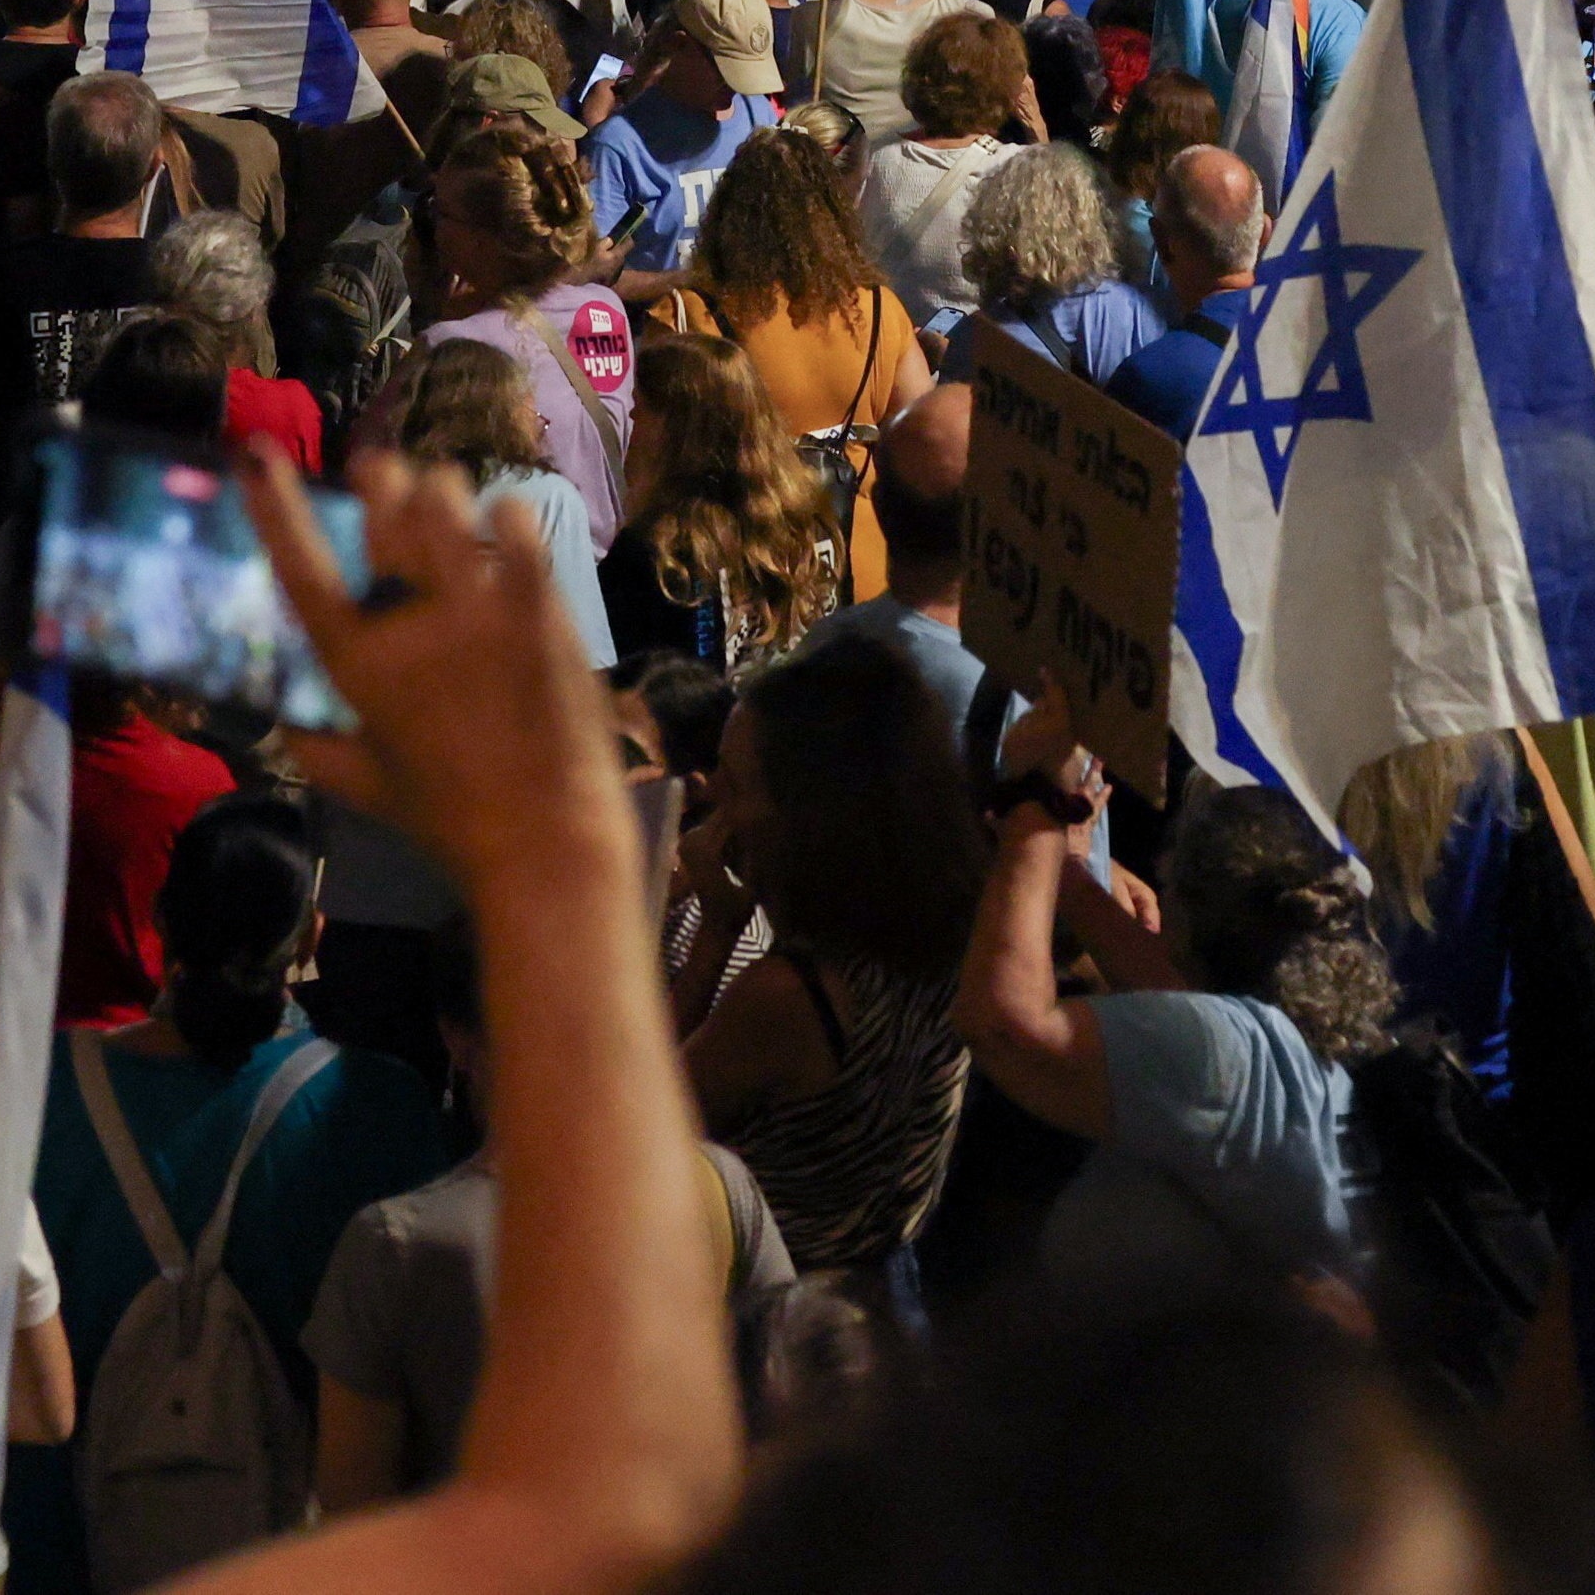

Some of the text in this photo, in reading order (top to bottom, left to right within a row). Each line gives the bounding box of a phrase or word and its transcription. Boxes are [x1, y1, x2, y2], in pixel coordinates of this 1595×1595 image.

[592, 312, 610, 325] 27.10
[575, 334, 628, 355] בוחרת
[583, 356, 623, 377] שינוי
